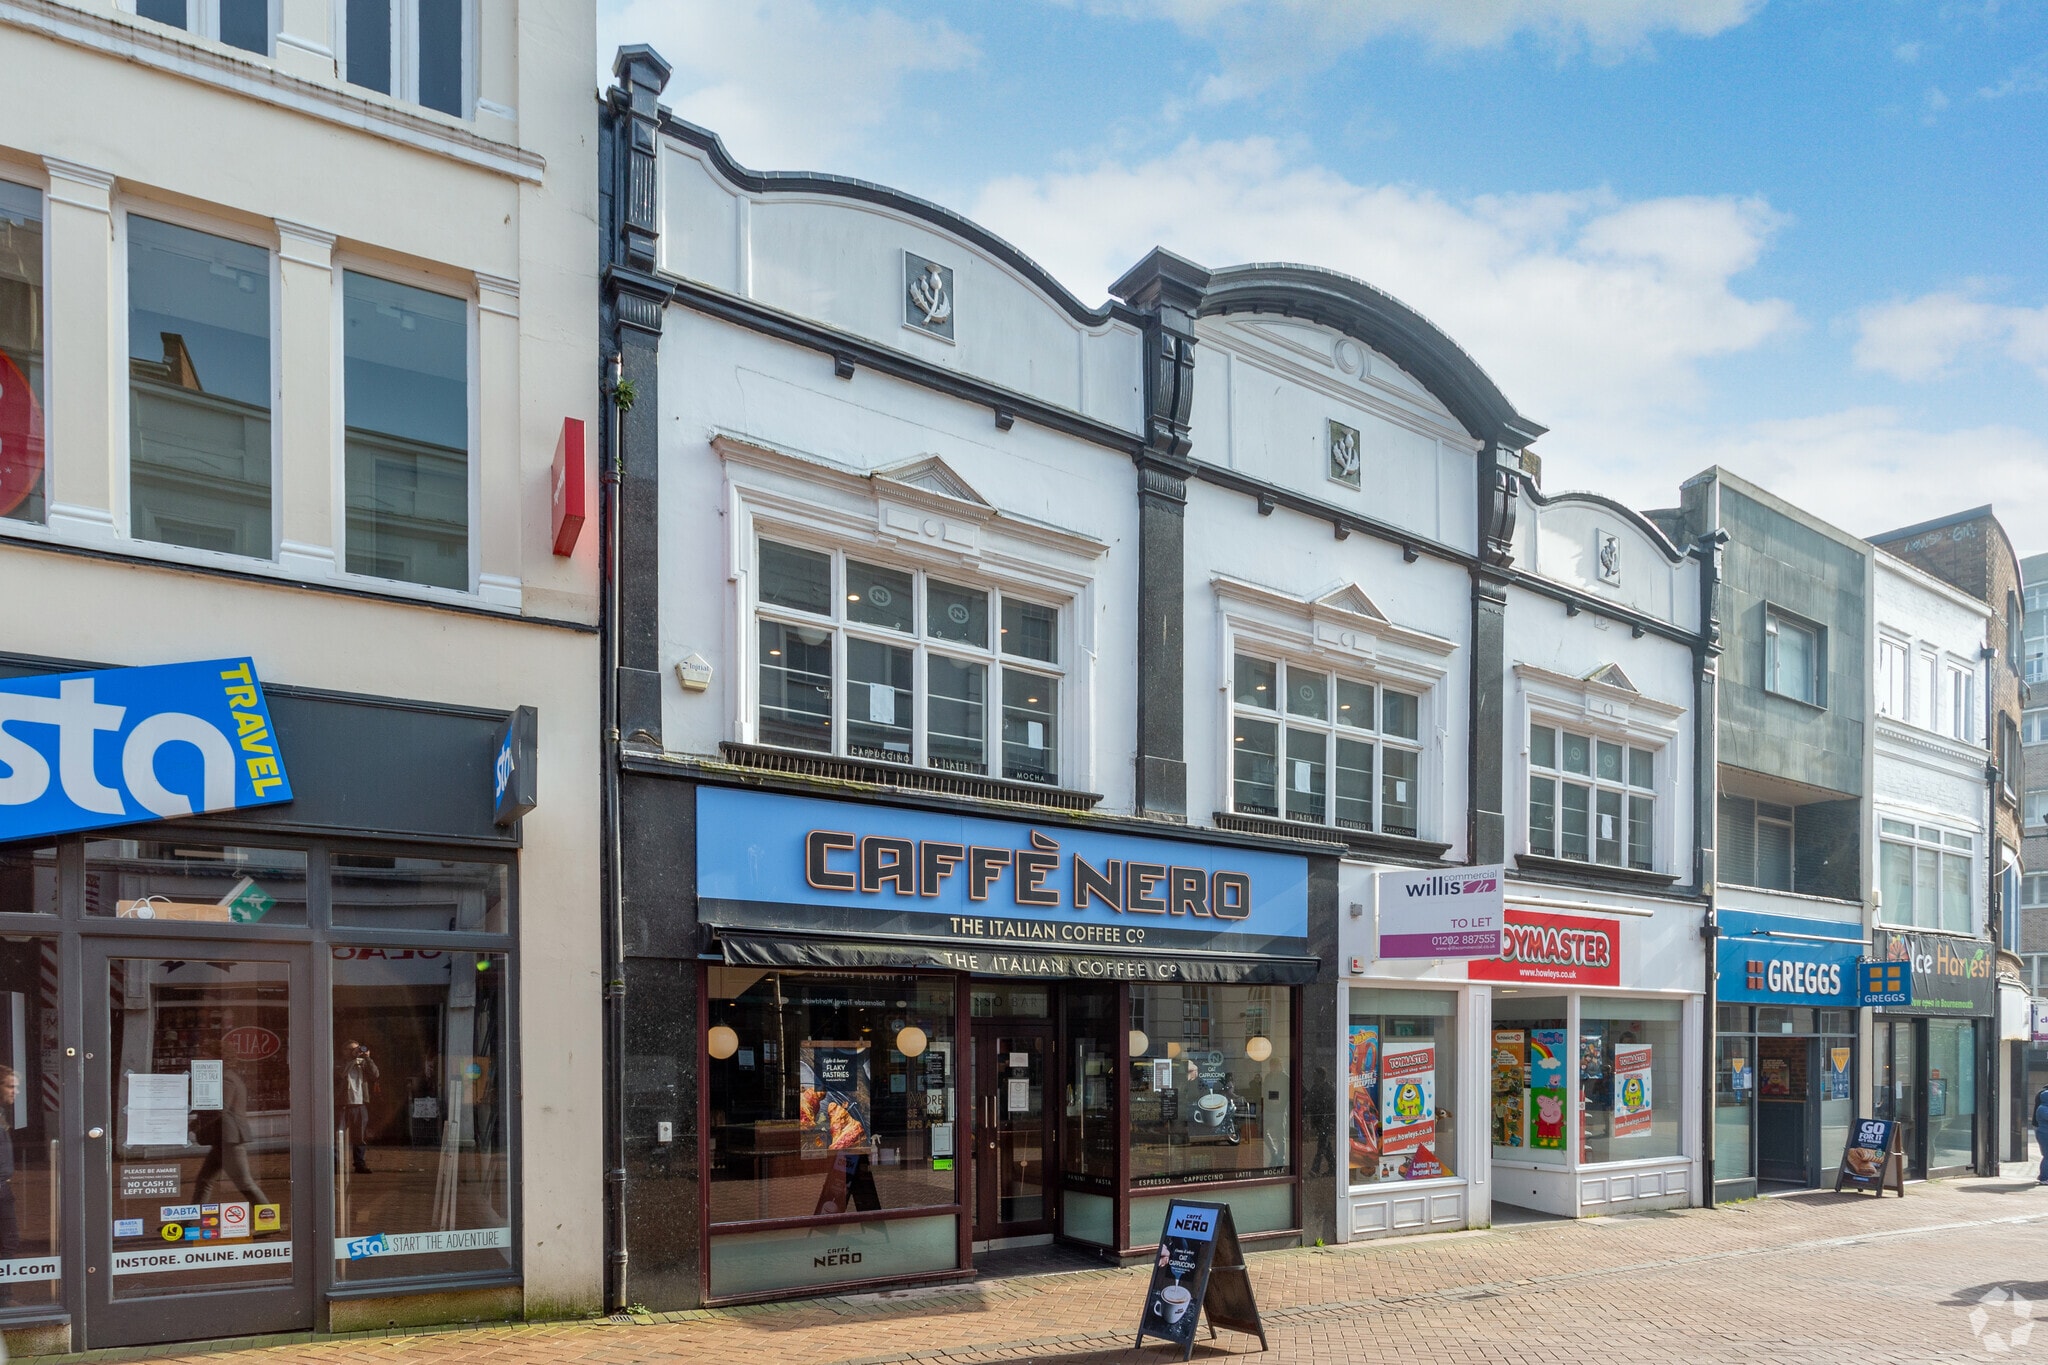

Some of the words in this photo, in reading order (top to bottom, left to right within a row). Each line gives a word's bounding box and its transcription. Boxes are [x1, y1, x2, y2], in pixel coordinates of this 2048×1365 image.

[220, 662, 282, 797] TRAVEL
[0, 677, 236, 820] sta
[945, 759, 968, 771] LATTE
[1016, 772, 1045, 782] MOCHA
[1243, 806, 1266, 815] PANINI
[1443, 869, 1498, 882] commercial
[1073, 852, 1251, 920] NERO
[1406, 876, 1461, 897] willis
[950, 917, 984, 935] THE
[989, 920, 1056, 941] ITALIAN
[1061, 924, 1121, 943] COFFEE
[1451, 918, 1468, 928] TO
[1471, 917, 1492, 928] LET
[1431, 935, 1460, 946] 01202
[1462, 934, 1496, 945] 887555
[1503, 924, 1610, 967] OYMASTER
[944, 953, 978, 970] THE
[993, 955, 1065, 974] ITALIAN
[1078, 960, 1146, 978] COFFEE
[1936, 944, 1991, 979] Harvest
[1519, 968, 1577, 979] www.howleys.co.uk
[1768, 959, 1841, 995] GREGGS
[1864, 993, 1906, 1003] GREGGS
[1389, 1053, 1429, 1069] TOYMASTER
[1384, 1126, 1433, 1144] www.howleys.co.uk
[1861, 1121, 1886, 1135] GO
[1859, 1132, 1874, 1141] FOR
[142, 1180, 164, 1188] CASH
[1095, 1178, 1112, 1186] PASTA
[1138, 1177, 1171, 1187] ESPRESSO
[1183, 1173, 1224, 1183] CAPPUCCINO
[1235, 1171, 1251, 1179] LATTE
[1263, 1168, 1285, 1176] MOCHA
[159, 1186, 177, 1194] SITE
[172, 1207, 198, 1216] ABTA
[1174, 1218, 1209, 1233] NERO
[351, 1238, 383, 1257] sta
[393, 1235, 421, 1252] START
[426, 1234, 443, 1250] THE
[446, 1230, 499, 1248] ADVENTURE
[116, 1255, 181, 1269] INSTORE.
[184, 1250, 239, 1263] ONLINE.
[242, 1247, 291, 1260] MOBILE
[814, 1252, 862, 1268] NERO
[1168, 1259, 1196, 1269] CAPPUCCINO
